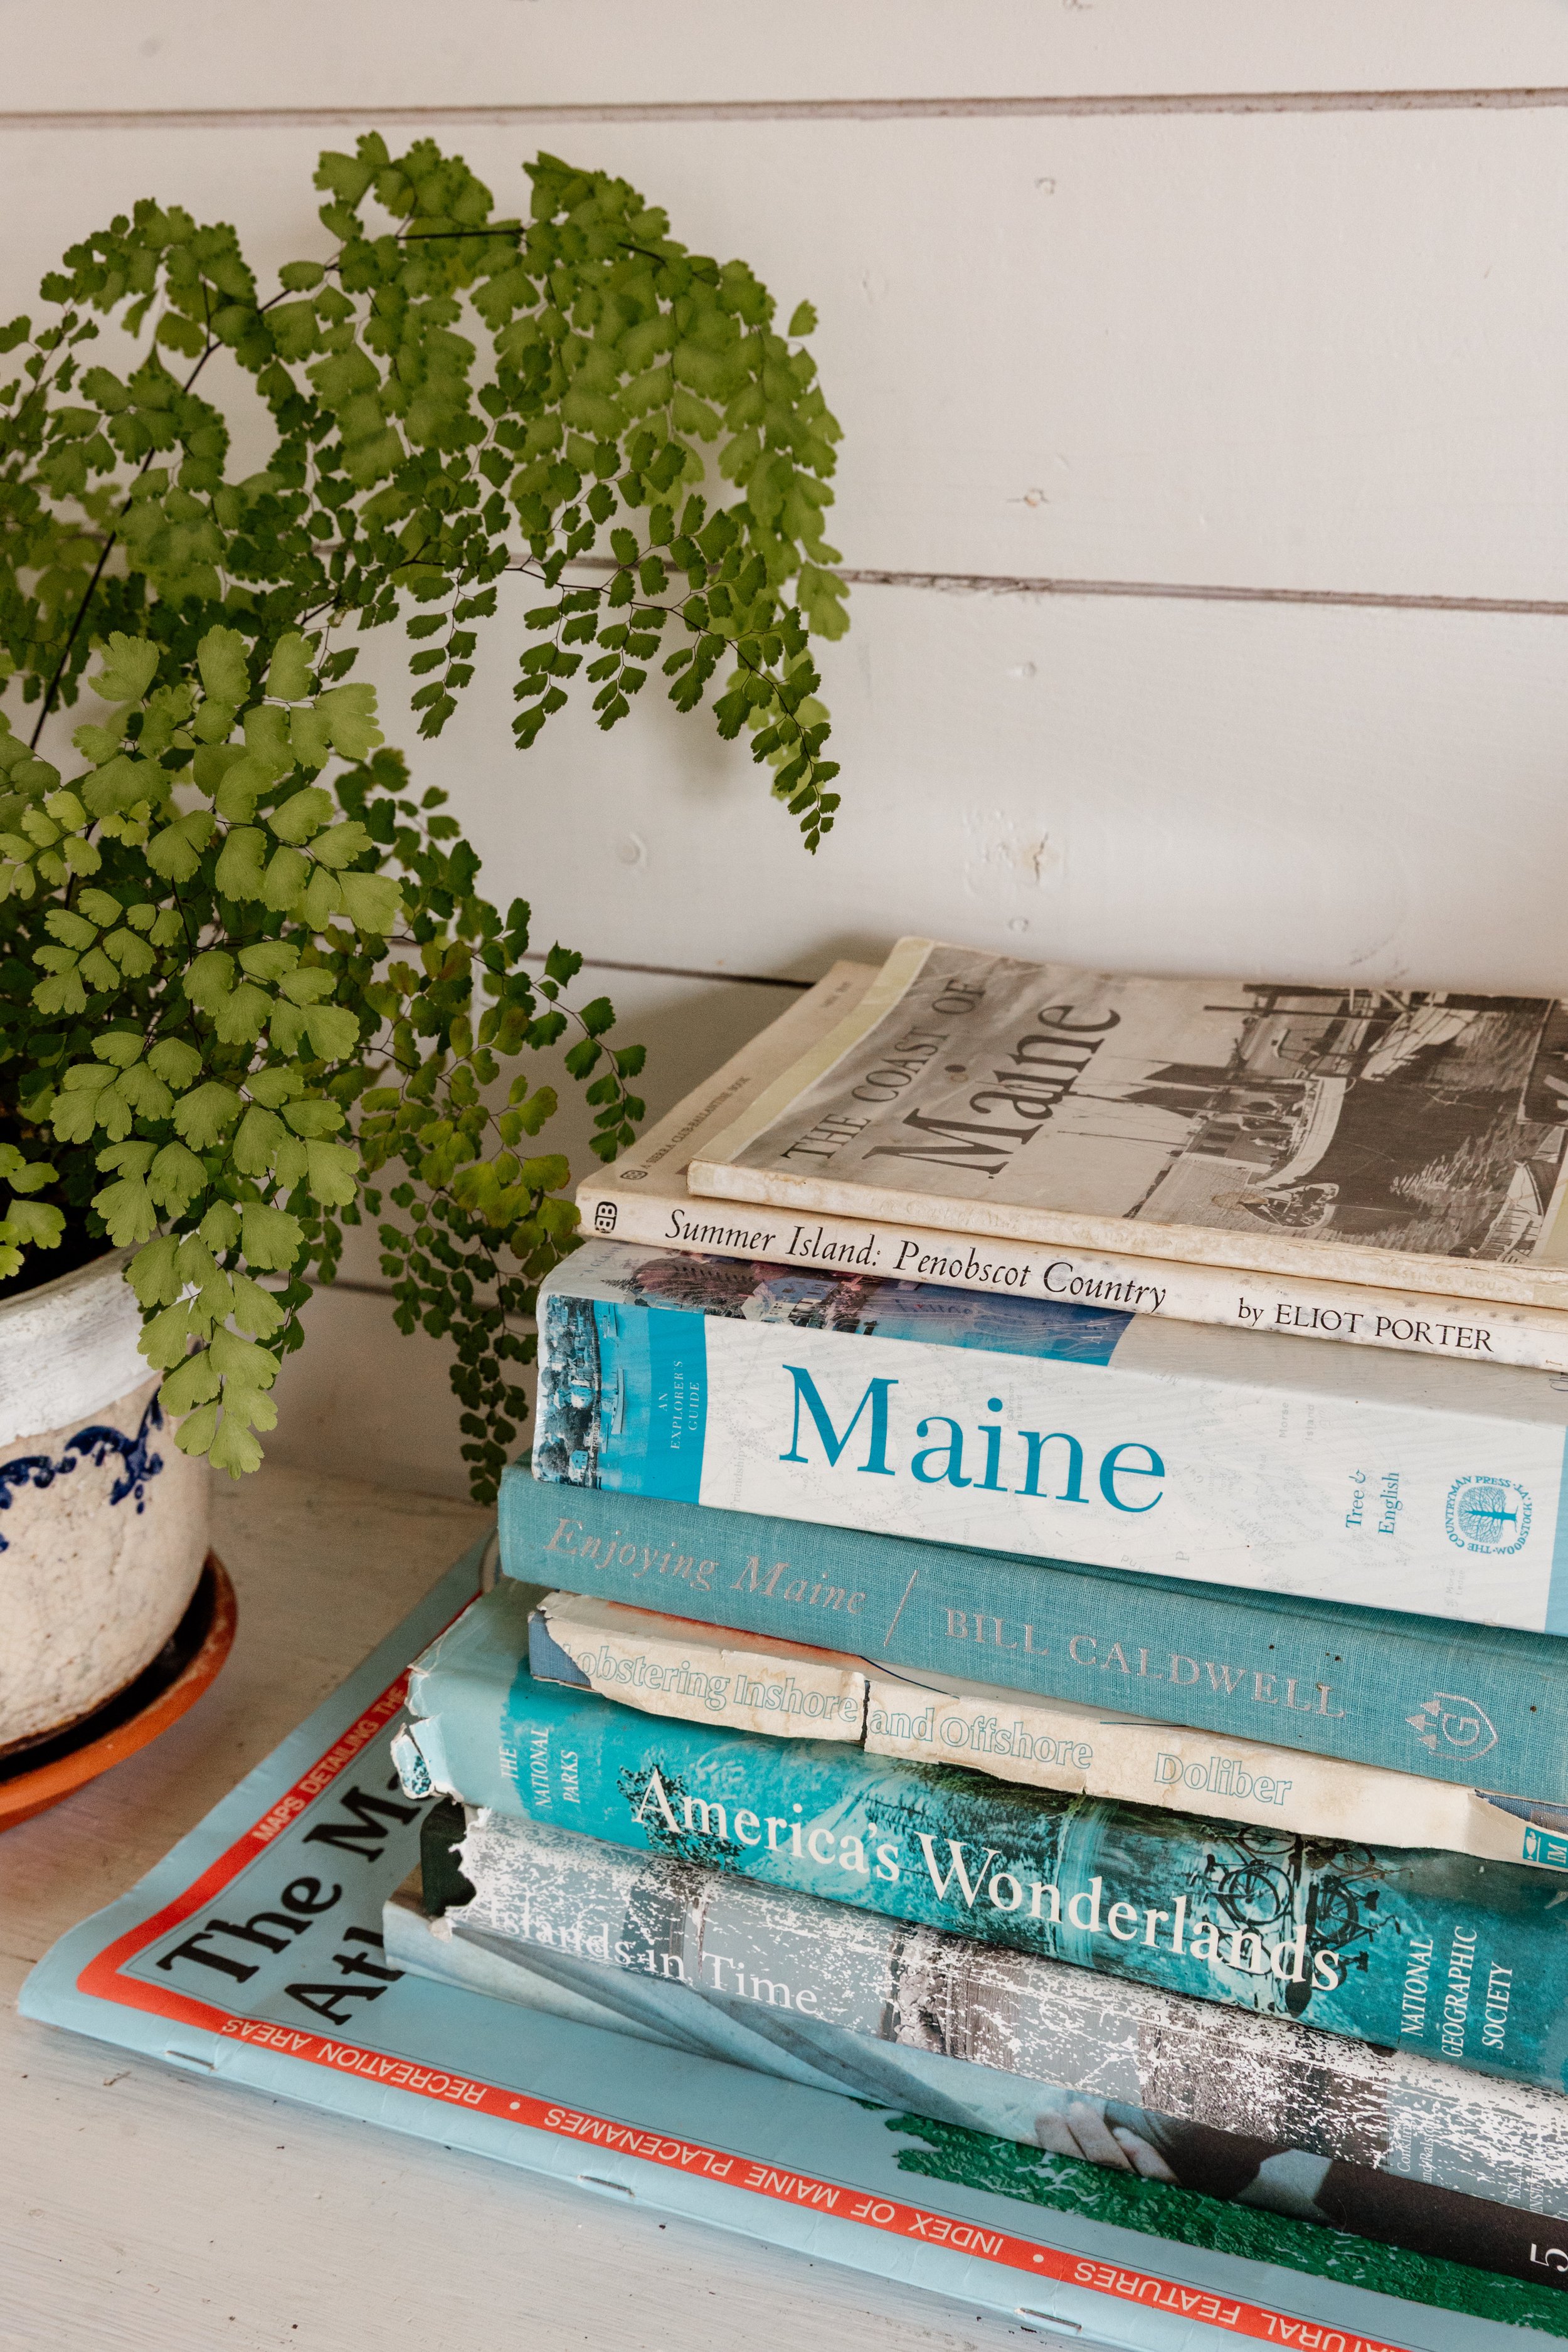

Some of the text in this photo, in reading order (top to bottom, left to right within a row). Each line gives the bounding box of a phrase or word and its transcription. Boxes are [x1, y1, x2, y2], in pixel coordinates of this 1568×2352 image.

[780, 1114, 871, 1160] THE
[852, 1025, 948, 1102] COAST
[932, 978, 989, 1015] OF
[862, 1005, 1121, 1175] Maine
[665, 1209, 1493, 1352] Summer Island: Penobscot Country by ELIOT PORTER
[659, 1392, 669, 1411] AN
[670, 1360, 684, 1449] EXPLORER'S
[688, 1382, 700, 1431] GUIDE
[779, 1364, 1165, 1513] Maine
[1345, 1470, 1366, 1528] Tree &
[1378, 1472, 1403, 1535] English
[1445, 1476, 1512, 1554] THE COUNTRYMAN PRESS
[543, 1517, 1345, 1718] Enjoying Maine BILL CALDWELL
[252, 1686, 405, 1841] MAPS DETAILING THE
[499, 1746, 519, 1779] THE
[530, 1727, 553, 1809] NATIONAL
[561, 1750, 581, 1803] PARKS
[733, 1675, 858, 1722] Inshore
[870, 1708, 935, 1742] and
[940, 1715, 1093, 1769] Offshore
[1154, 1752, 1292, 1805] Doliber
[632, 1767, 1341, 1992] America's Wonderlands
[156, 1876, 342, 1984] The
[644, 1937, 687, 1981] in
[701, 1951, 818, 2015] Time
[1401, 1939, 1434, 2037] NATIONAL
[1441, 1926, 1478, 2057] GEOGRAPHIC
[1482, 1961, 1513, 2050] SOCIETY
[222, 2019, 312, 2051] AREAS
[317, 2042, 488, 2105] RECREATION
[544, 2109, 734, 2176] PLACENAMES
[744, 2165, 840, 2208] MAINE
[850, 2200, 895, 2223] OF
[908, 2213, 1004, 2256] INDEX
[1073, 2262, 1241, 2325] FEATURES
